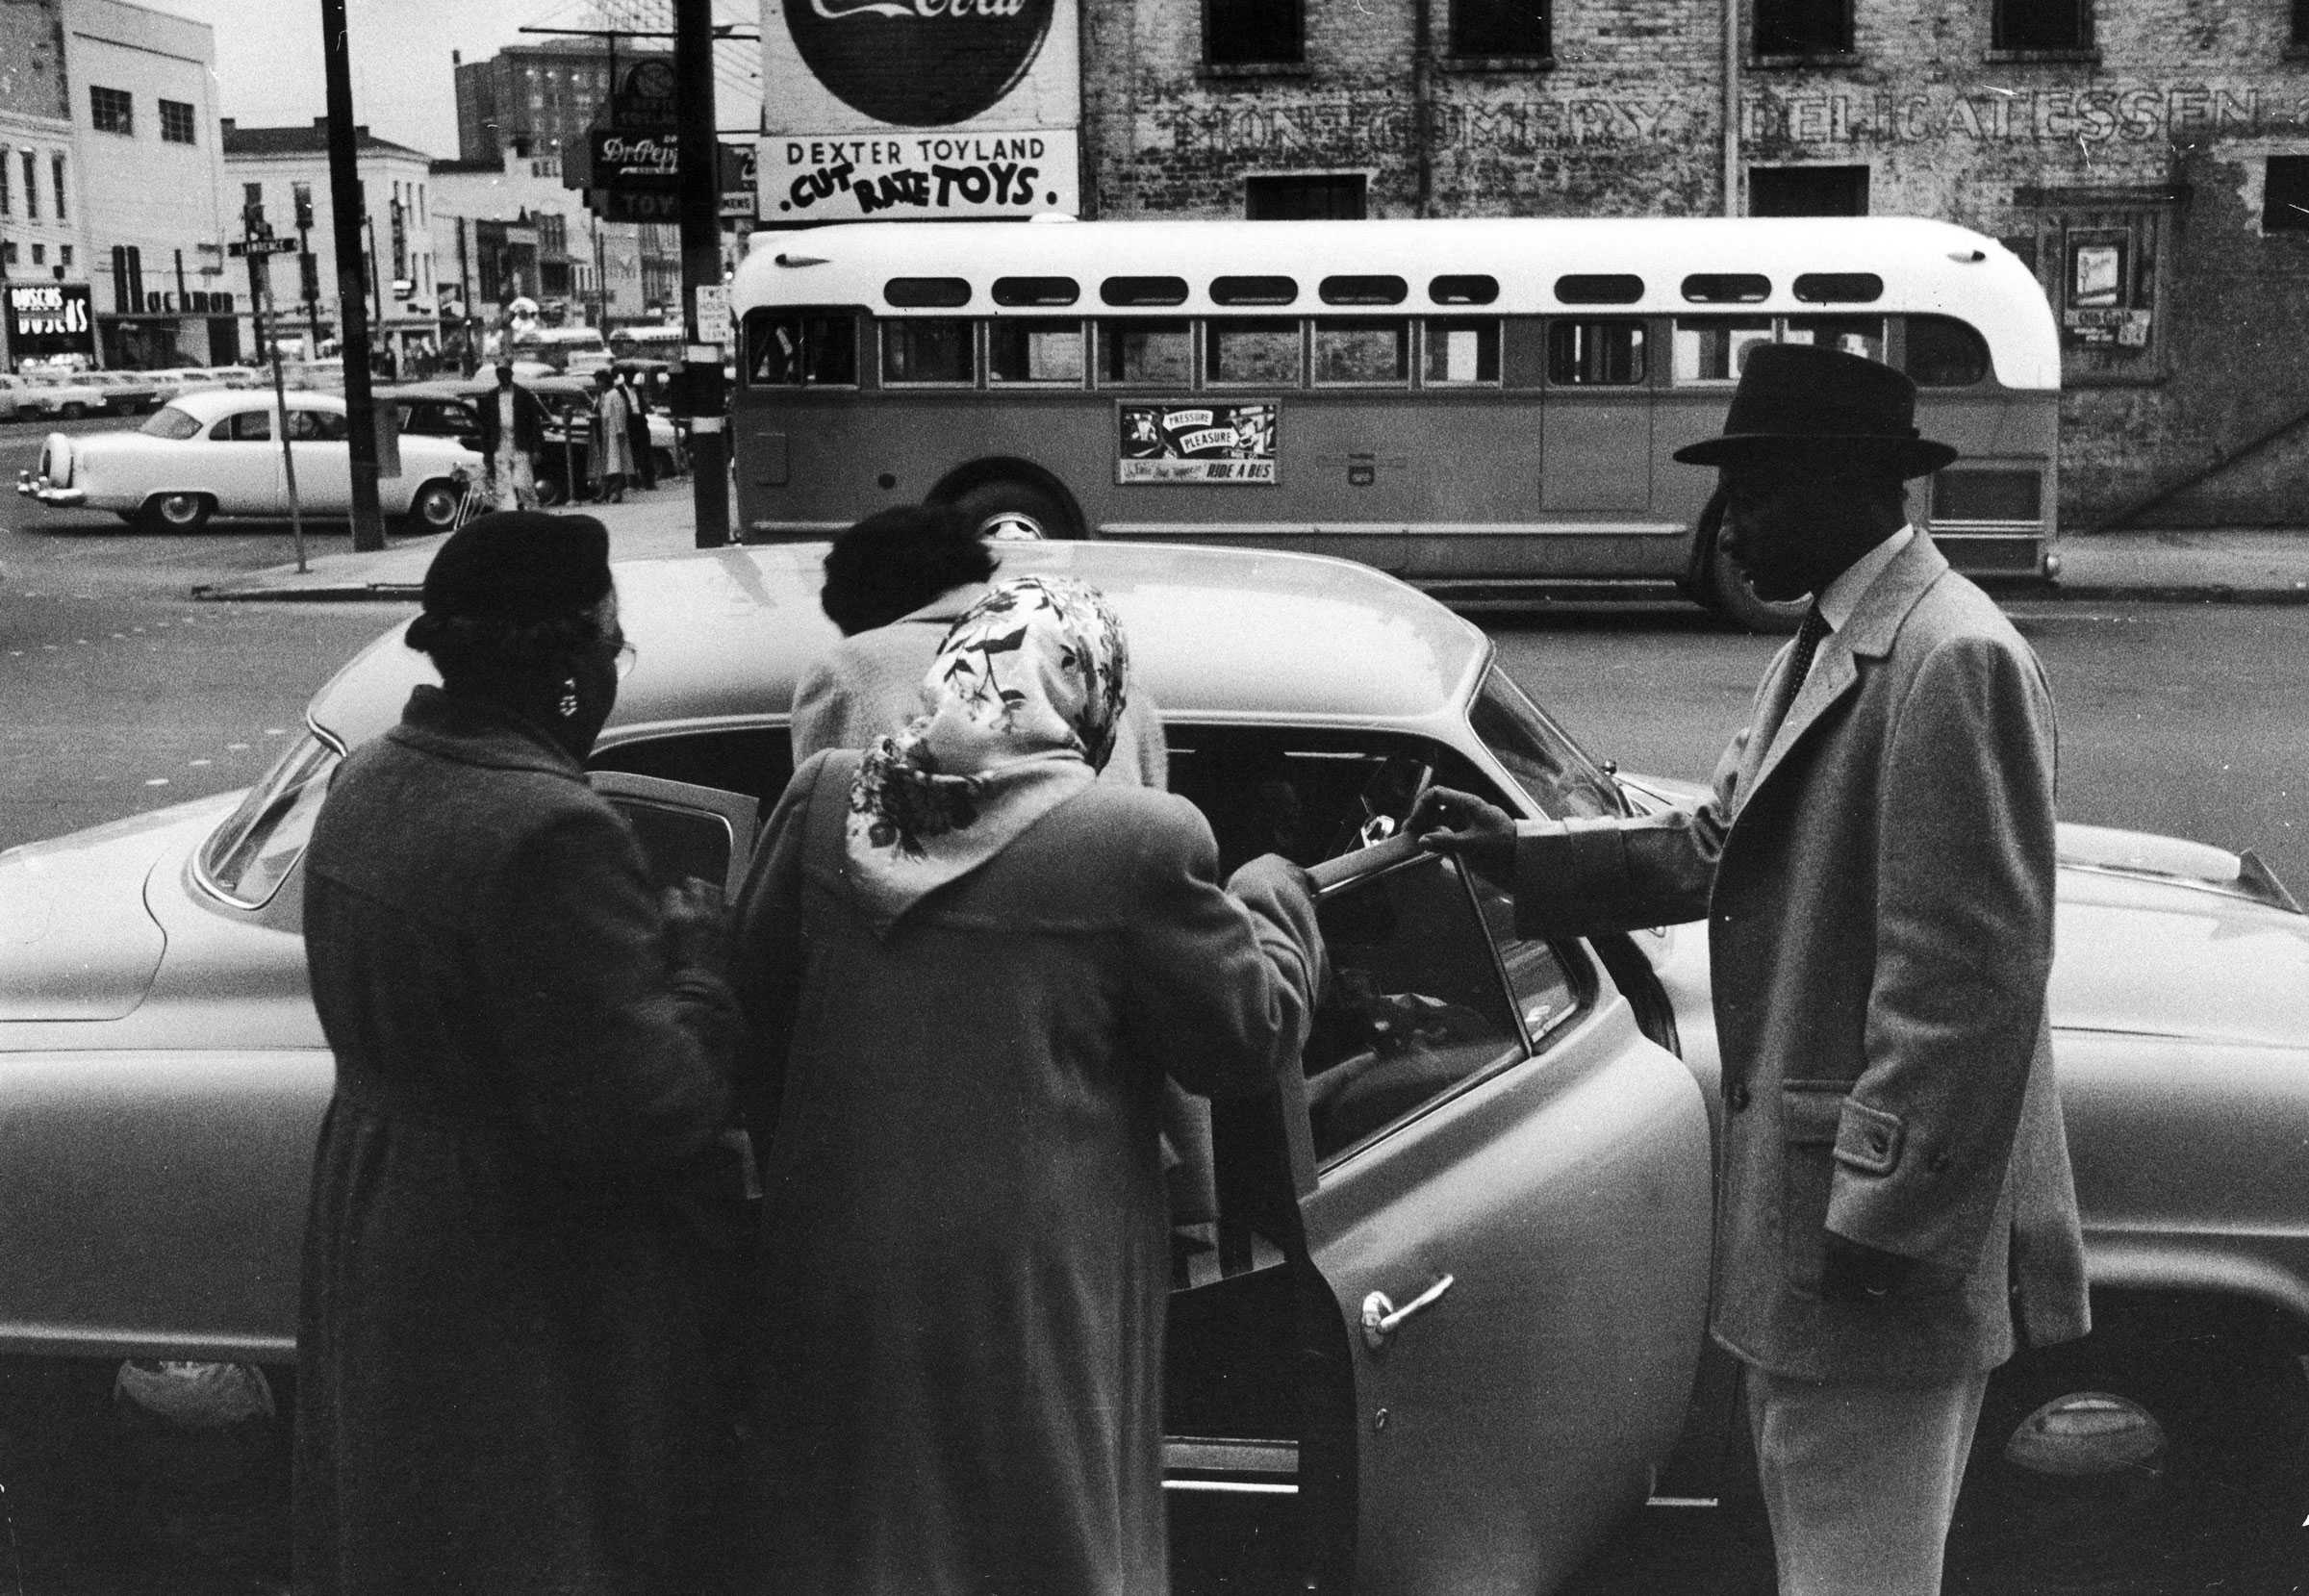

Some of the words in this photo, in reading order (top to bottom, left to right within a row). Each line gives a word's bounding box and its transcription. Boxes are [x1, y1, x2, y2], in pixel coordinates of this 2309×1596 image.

[1739, 88, 2260, 143] DELICATESSEN
[786, 141, 901, 165] DEXTER
[917, 139, 1044, 162] TOYLAND
[789, 162, 855, 209] CUT
[852, 168, 930, 215] RATE
[931, 162, 1039, 207] TOYS
[1169, 412, 1209, 426] PRESSURE
[1184, 431, 1231, 449] PLEASURE
[1206, 463, 1233, 478] RIDE
[1236, 464, 1246, 478] A
[1247, 463, 1272, 478] BUS
